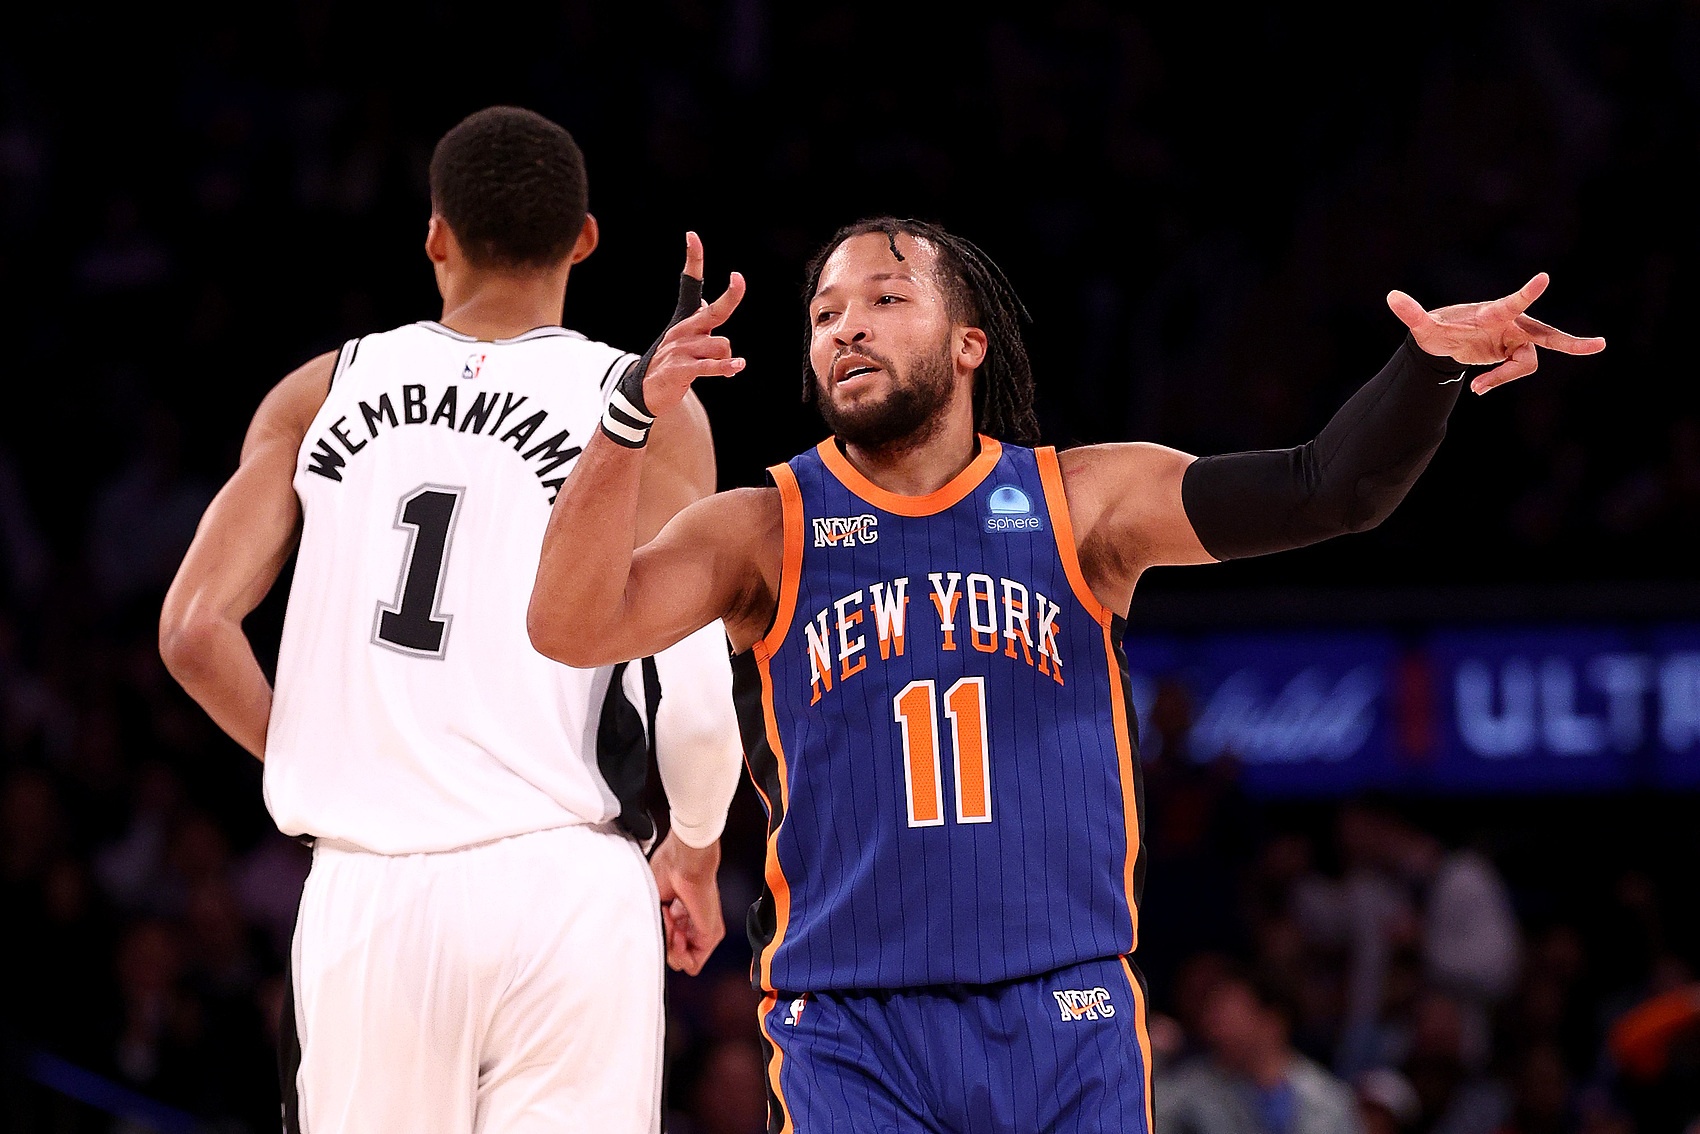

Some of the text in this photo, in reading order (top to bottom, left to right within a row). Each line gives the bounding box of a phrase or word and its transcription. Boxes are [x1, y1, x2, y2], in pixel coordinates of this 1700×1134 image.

[812, 514, 879, 548] NYC
[987, 516, 1039, 531] sphere
[370, 482, 467, 660] 1
[804, 572, 1064, 706] NEW YORK
[893, 676, 992, 828] 11
[1052, 987, 1116, 1022] NYC
